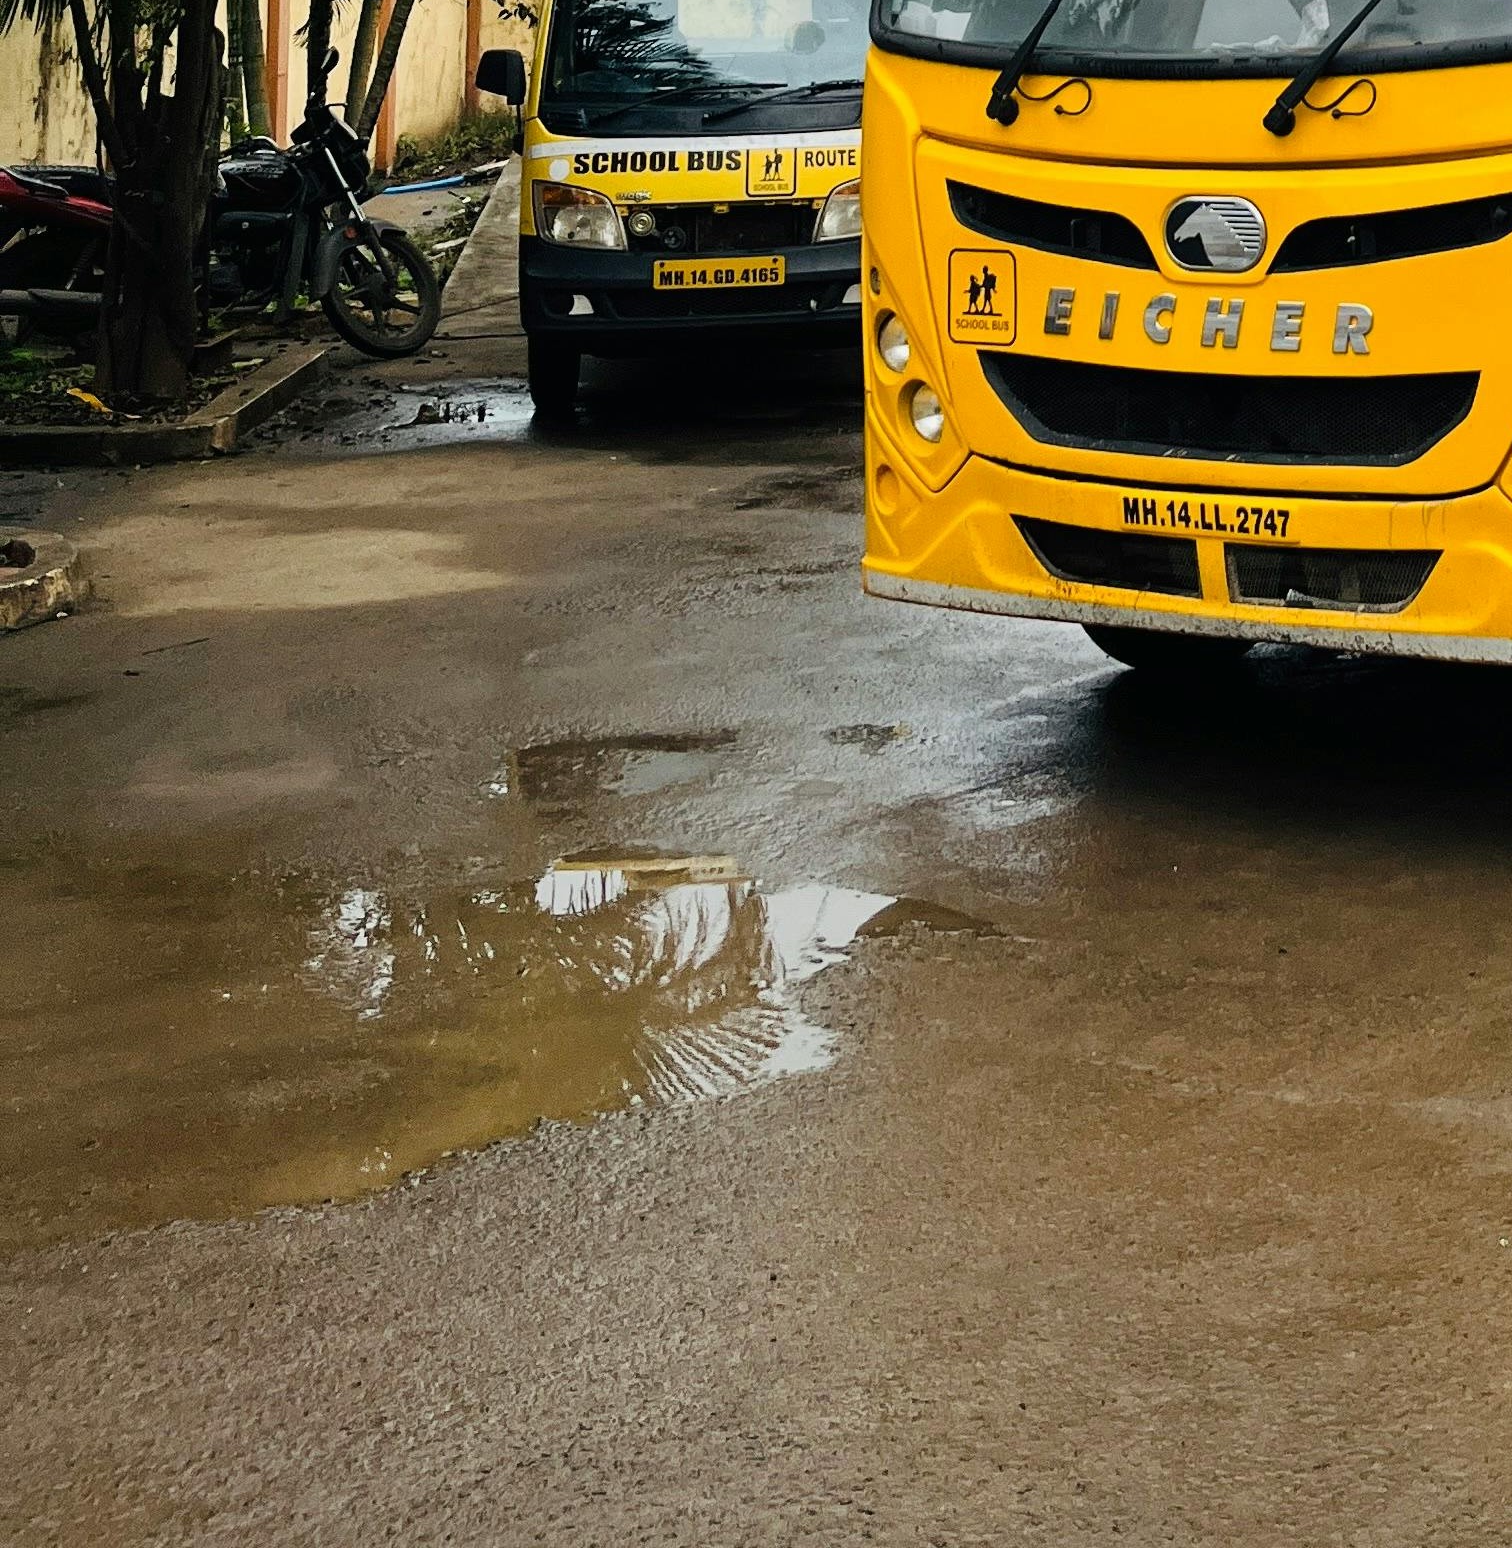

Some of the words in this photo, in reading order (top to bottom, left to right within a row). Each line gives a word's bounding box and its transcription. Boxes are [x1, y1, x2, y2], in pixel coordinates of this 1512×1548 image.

[573, 151, 680, 174] SCHOOL
[687, 150, 741, 171] BUS
[804, 148, 857, 168] ROUTE
[659, 267, 780, 286] MH.14.GD.4165
[955, 318, 990, 330] SCHOOL
[991, 319, 1010, 332] BUS
[1043, 287, 1374, 353] EICHER
[1122, 497, 1290, 538] MH.14.LL.2747
